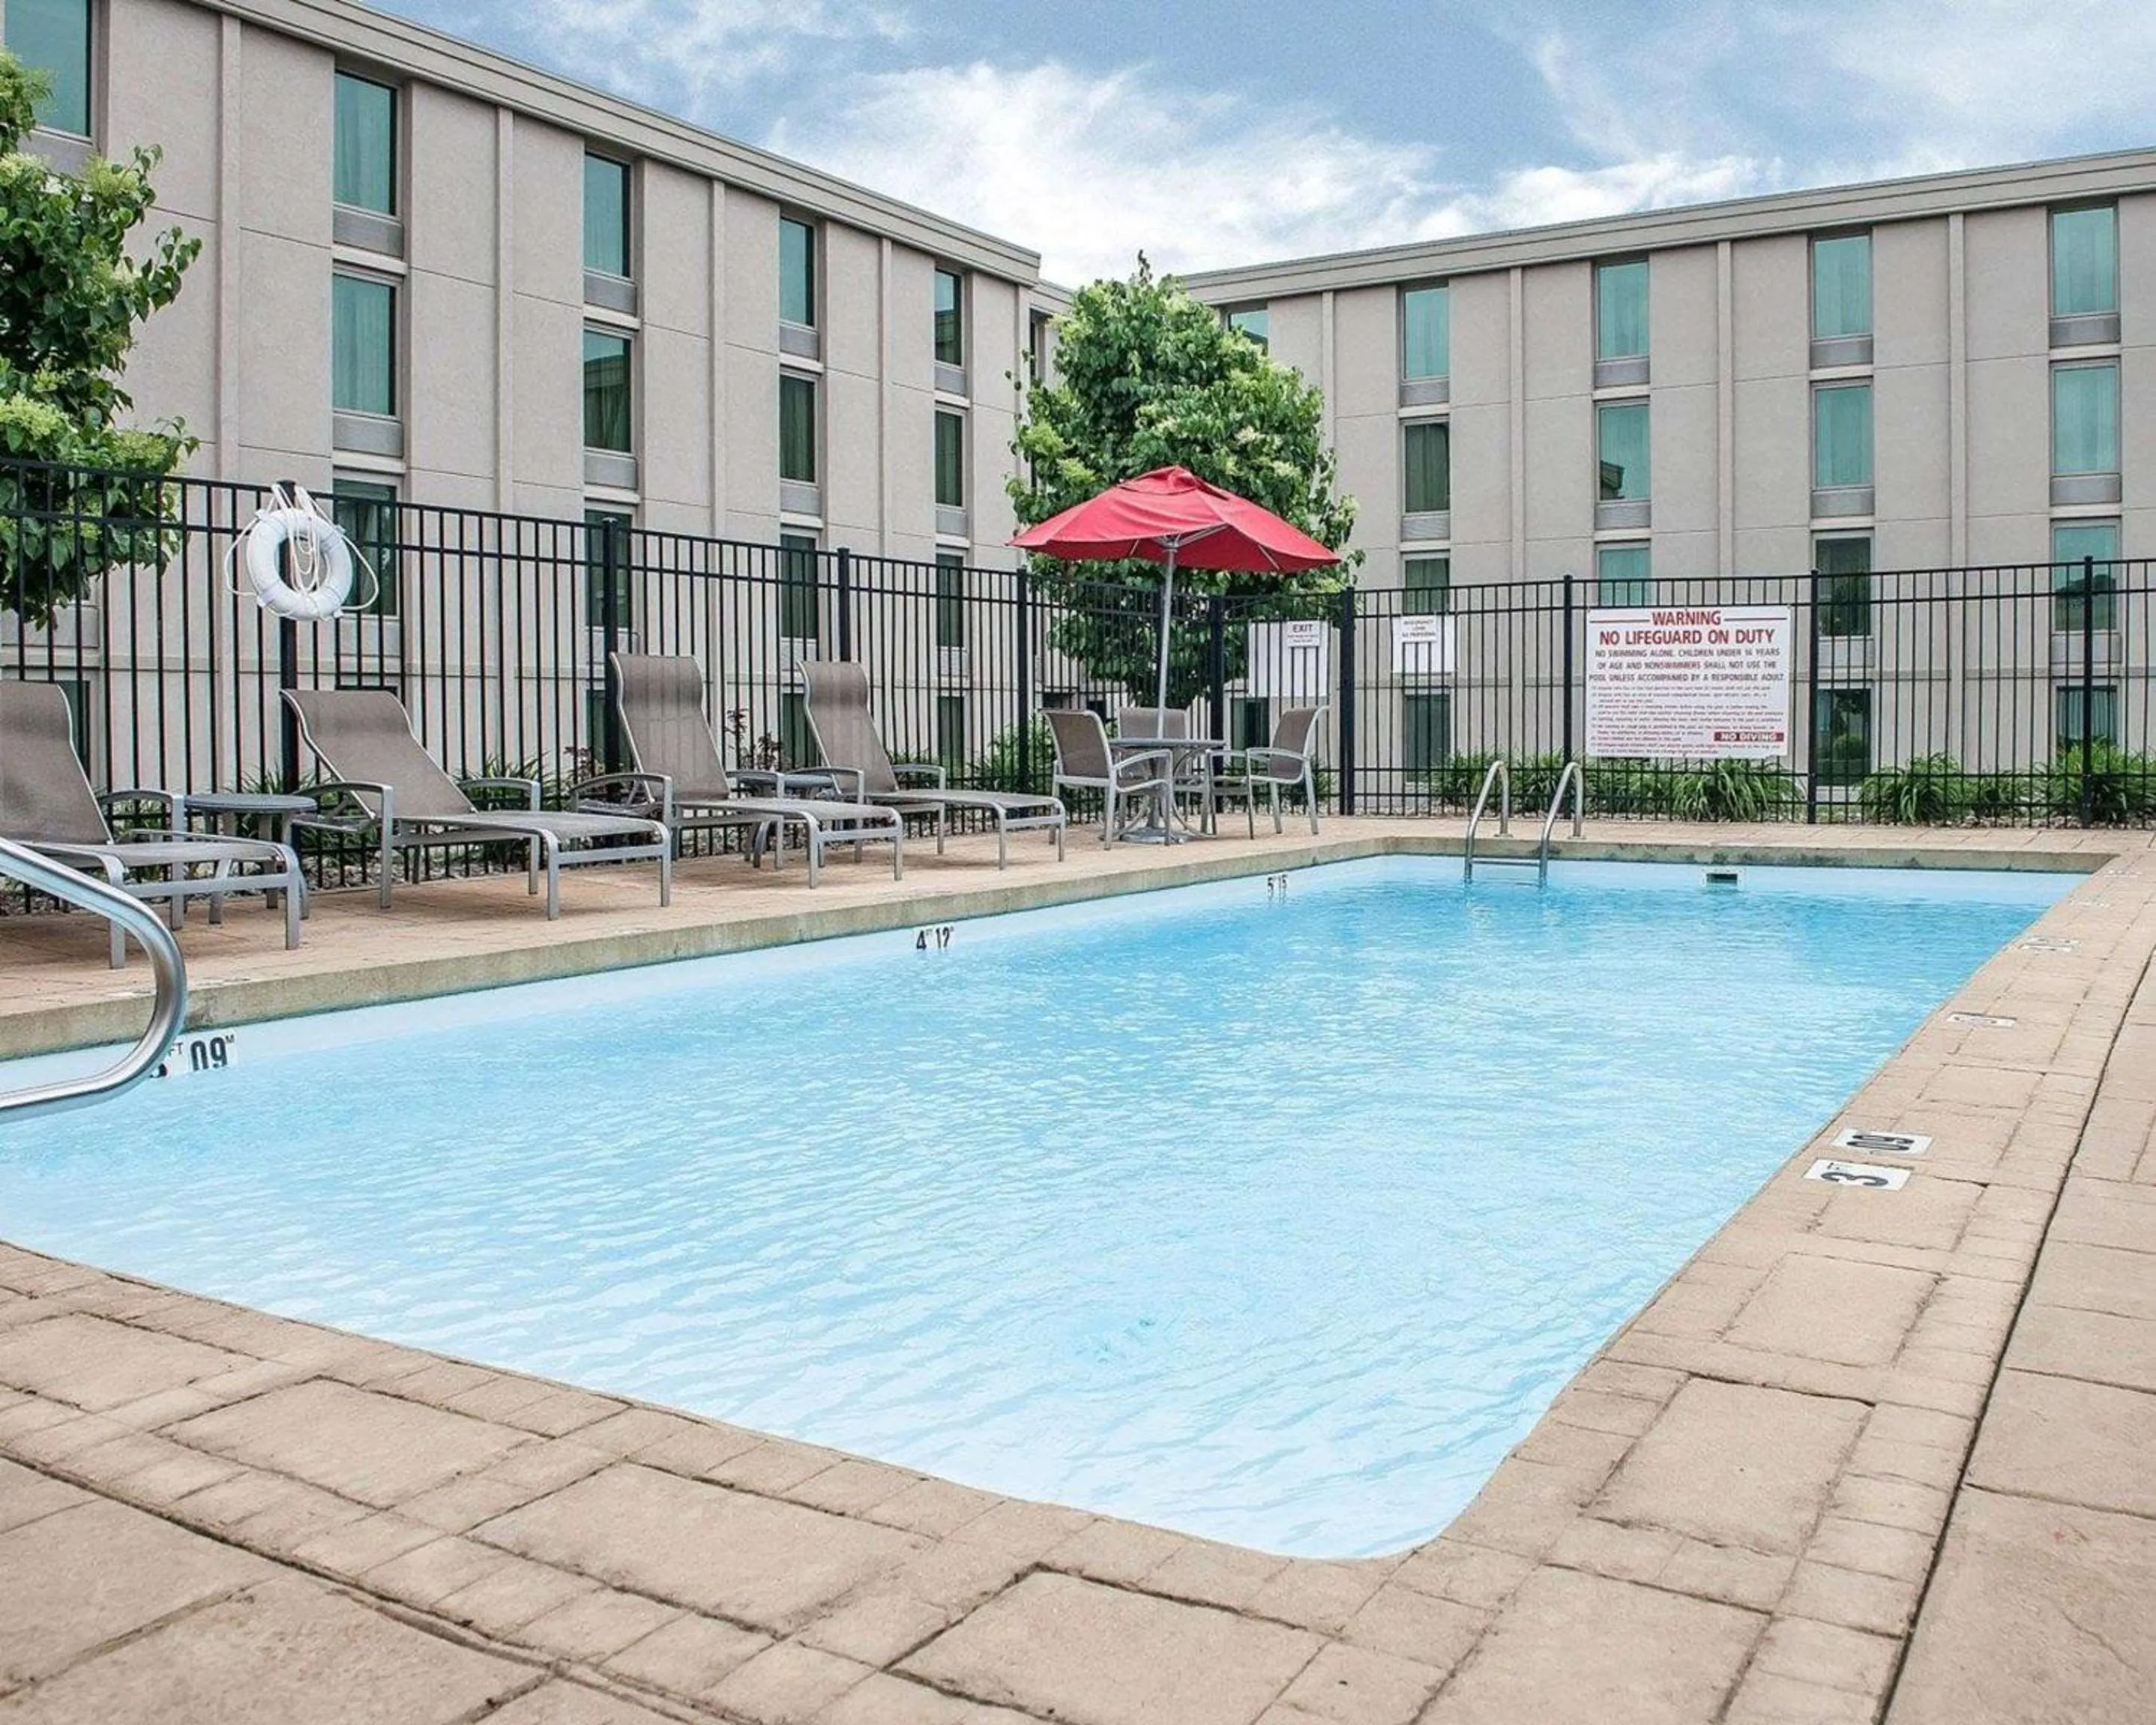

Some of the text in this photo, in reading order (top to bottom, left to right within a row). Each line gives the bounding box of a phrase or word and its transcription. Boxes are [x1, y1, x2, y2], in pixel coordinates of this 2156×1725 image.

[1652, 610, 1721, 625] WARNING
[1293, 624, 1312, 633] EXIT
[1600, 629, 1775, 645] NO LIFEGUARD ON DUTY
[1721, 733, 1776, 741] NO DIVING
